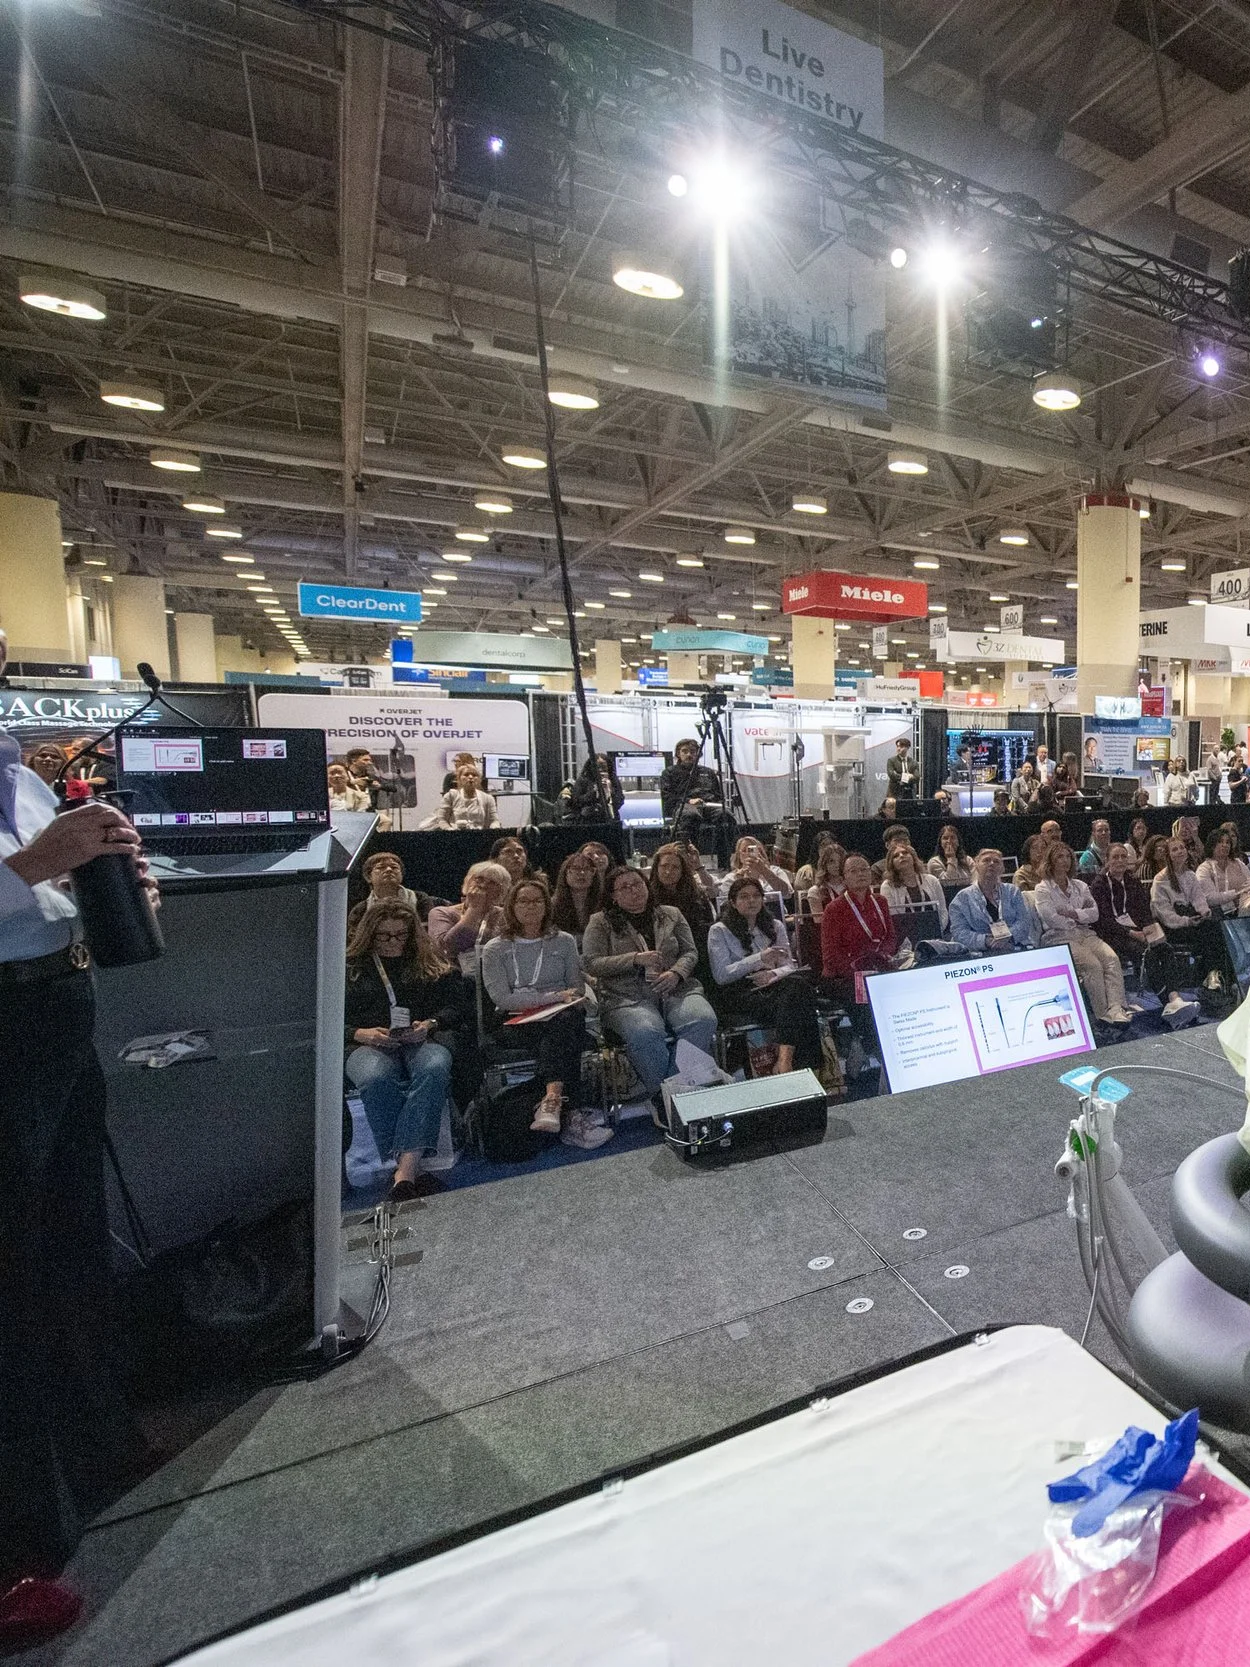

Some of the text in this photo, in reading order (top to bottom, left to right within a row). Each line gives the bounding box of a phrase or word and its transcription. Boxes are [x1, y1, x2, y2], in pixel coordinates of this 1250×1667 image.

[761, 29, 825, 78] Live
[719, 47, 864, 132] Dentistry
[788, 586, 809, 602] Miele
[840, 585, 905, 604] Miele
[1218, 578, 1242, 595] 400
[316, 595, 407, 613] ClearDent
[1004, 612, 1019, 625] 600
[481, 648, 526, 659] dentalcorp
[349, 716, 453, 727] DISCOVER THE
[325, 728, 483, 739] RECISION OF OVERJET
[981, 964, 994, 973] PS
